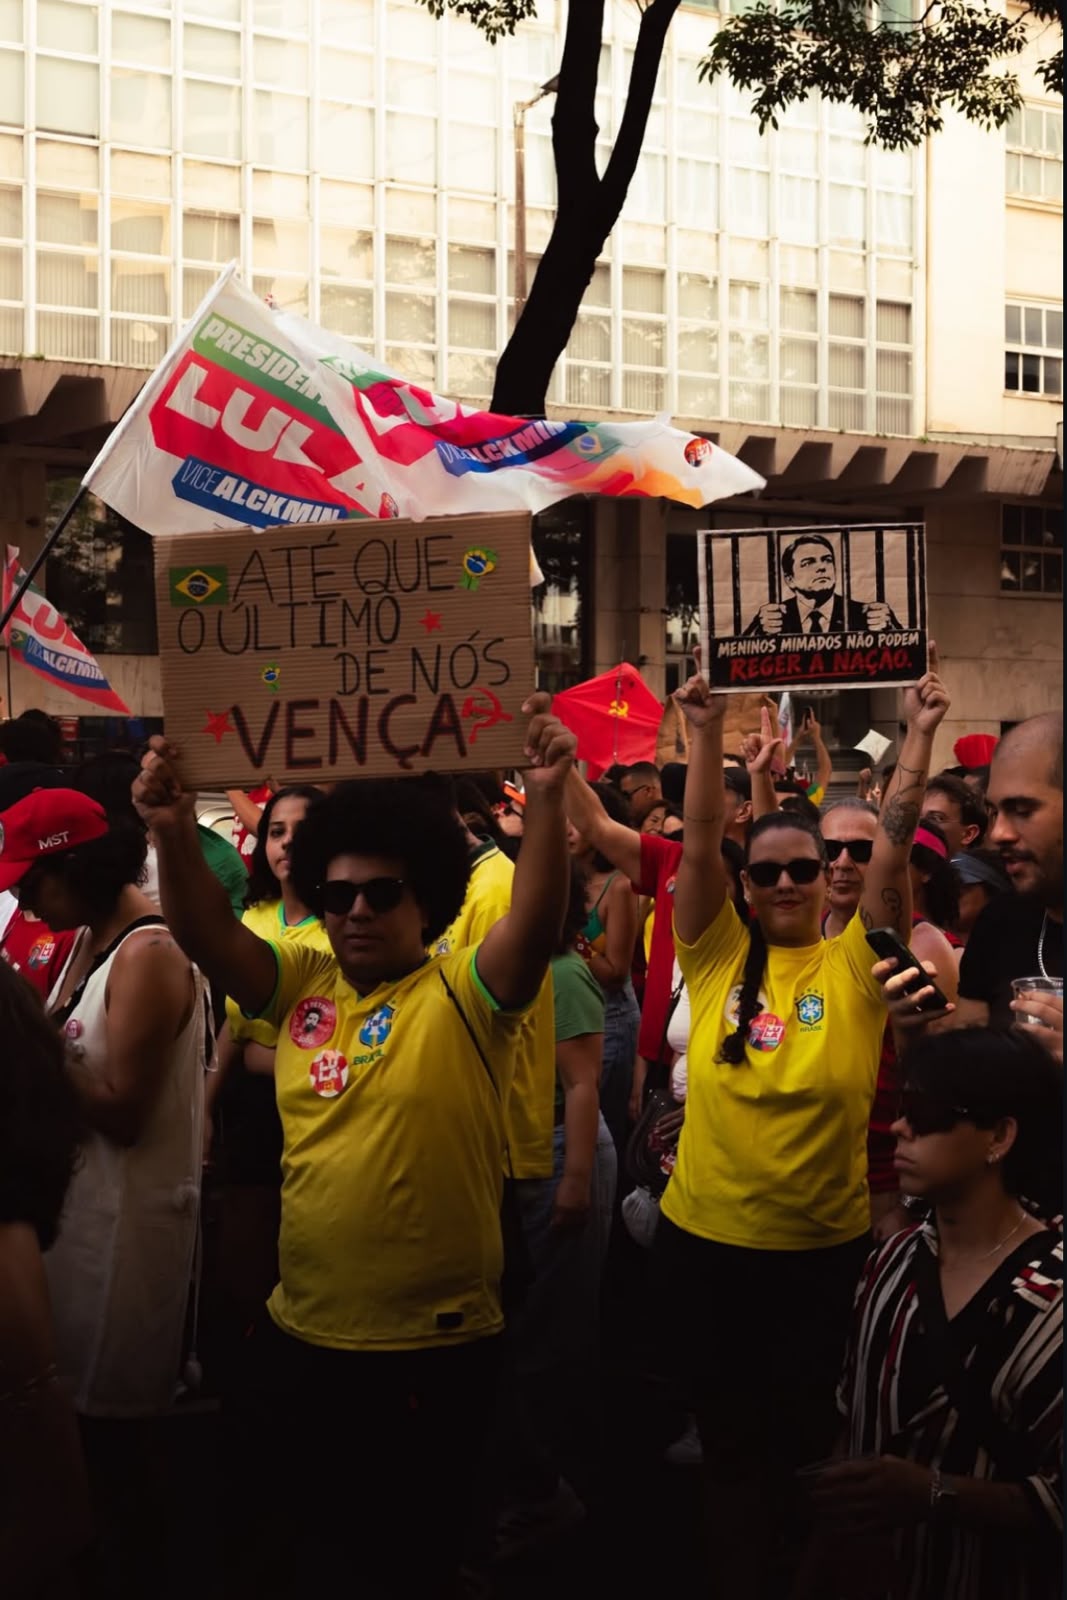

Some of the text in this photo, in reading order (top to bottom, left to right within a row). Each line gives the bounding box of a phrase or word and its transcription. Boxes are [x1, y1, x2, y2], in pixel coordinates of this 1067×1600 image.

[199, 318, 327, 407] PRESIDEN
[181, 459, 340, 523] VICE ALCKMIN
[232, 530, 454, 603] ATÉ QUE
[178, 595, 401, 656] O ÚLTIMO
[717, 630, 920, 658] MENINOS MIMADOS NÃO PODEM
[334, 630, 512, 697] DE NÓS
[730, 647, 913, 682] REGER A NAÇÃO.
[230, 692, 468, 770] VENÇA
[38, 831, 70, 850] MST
